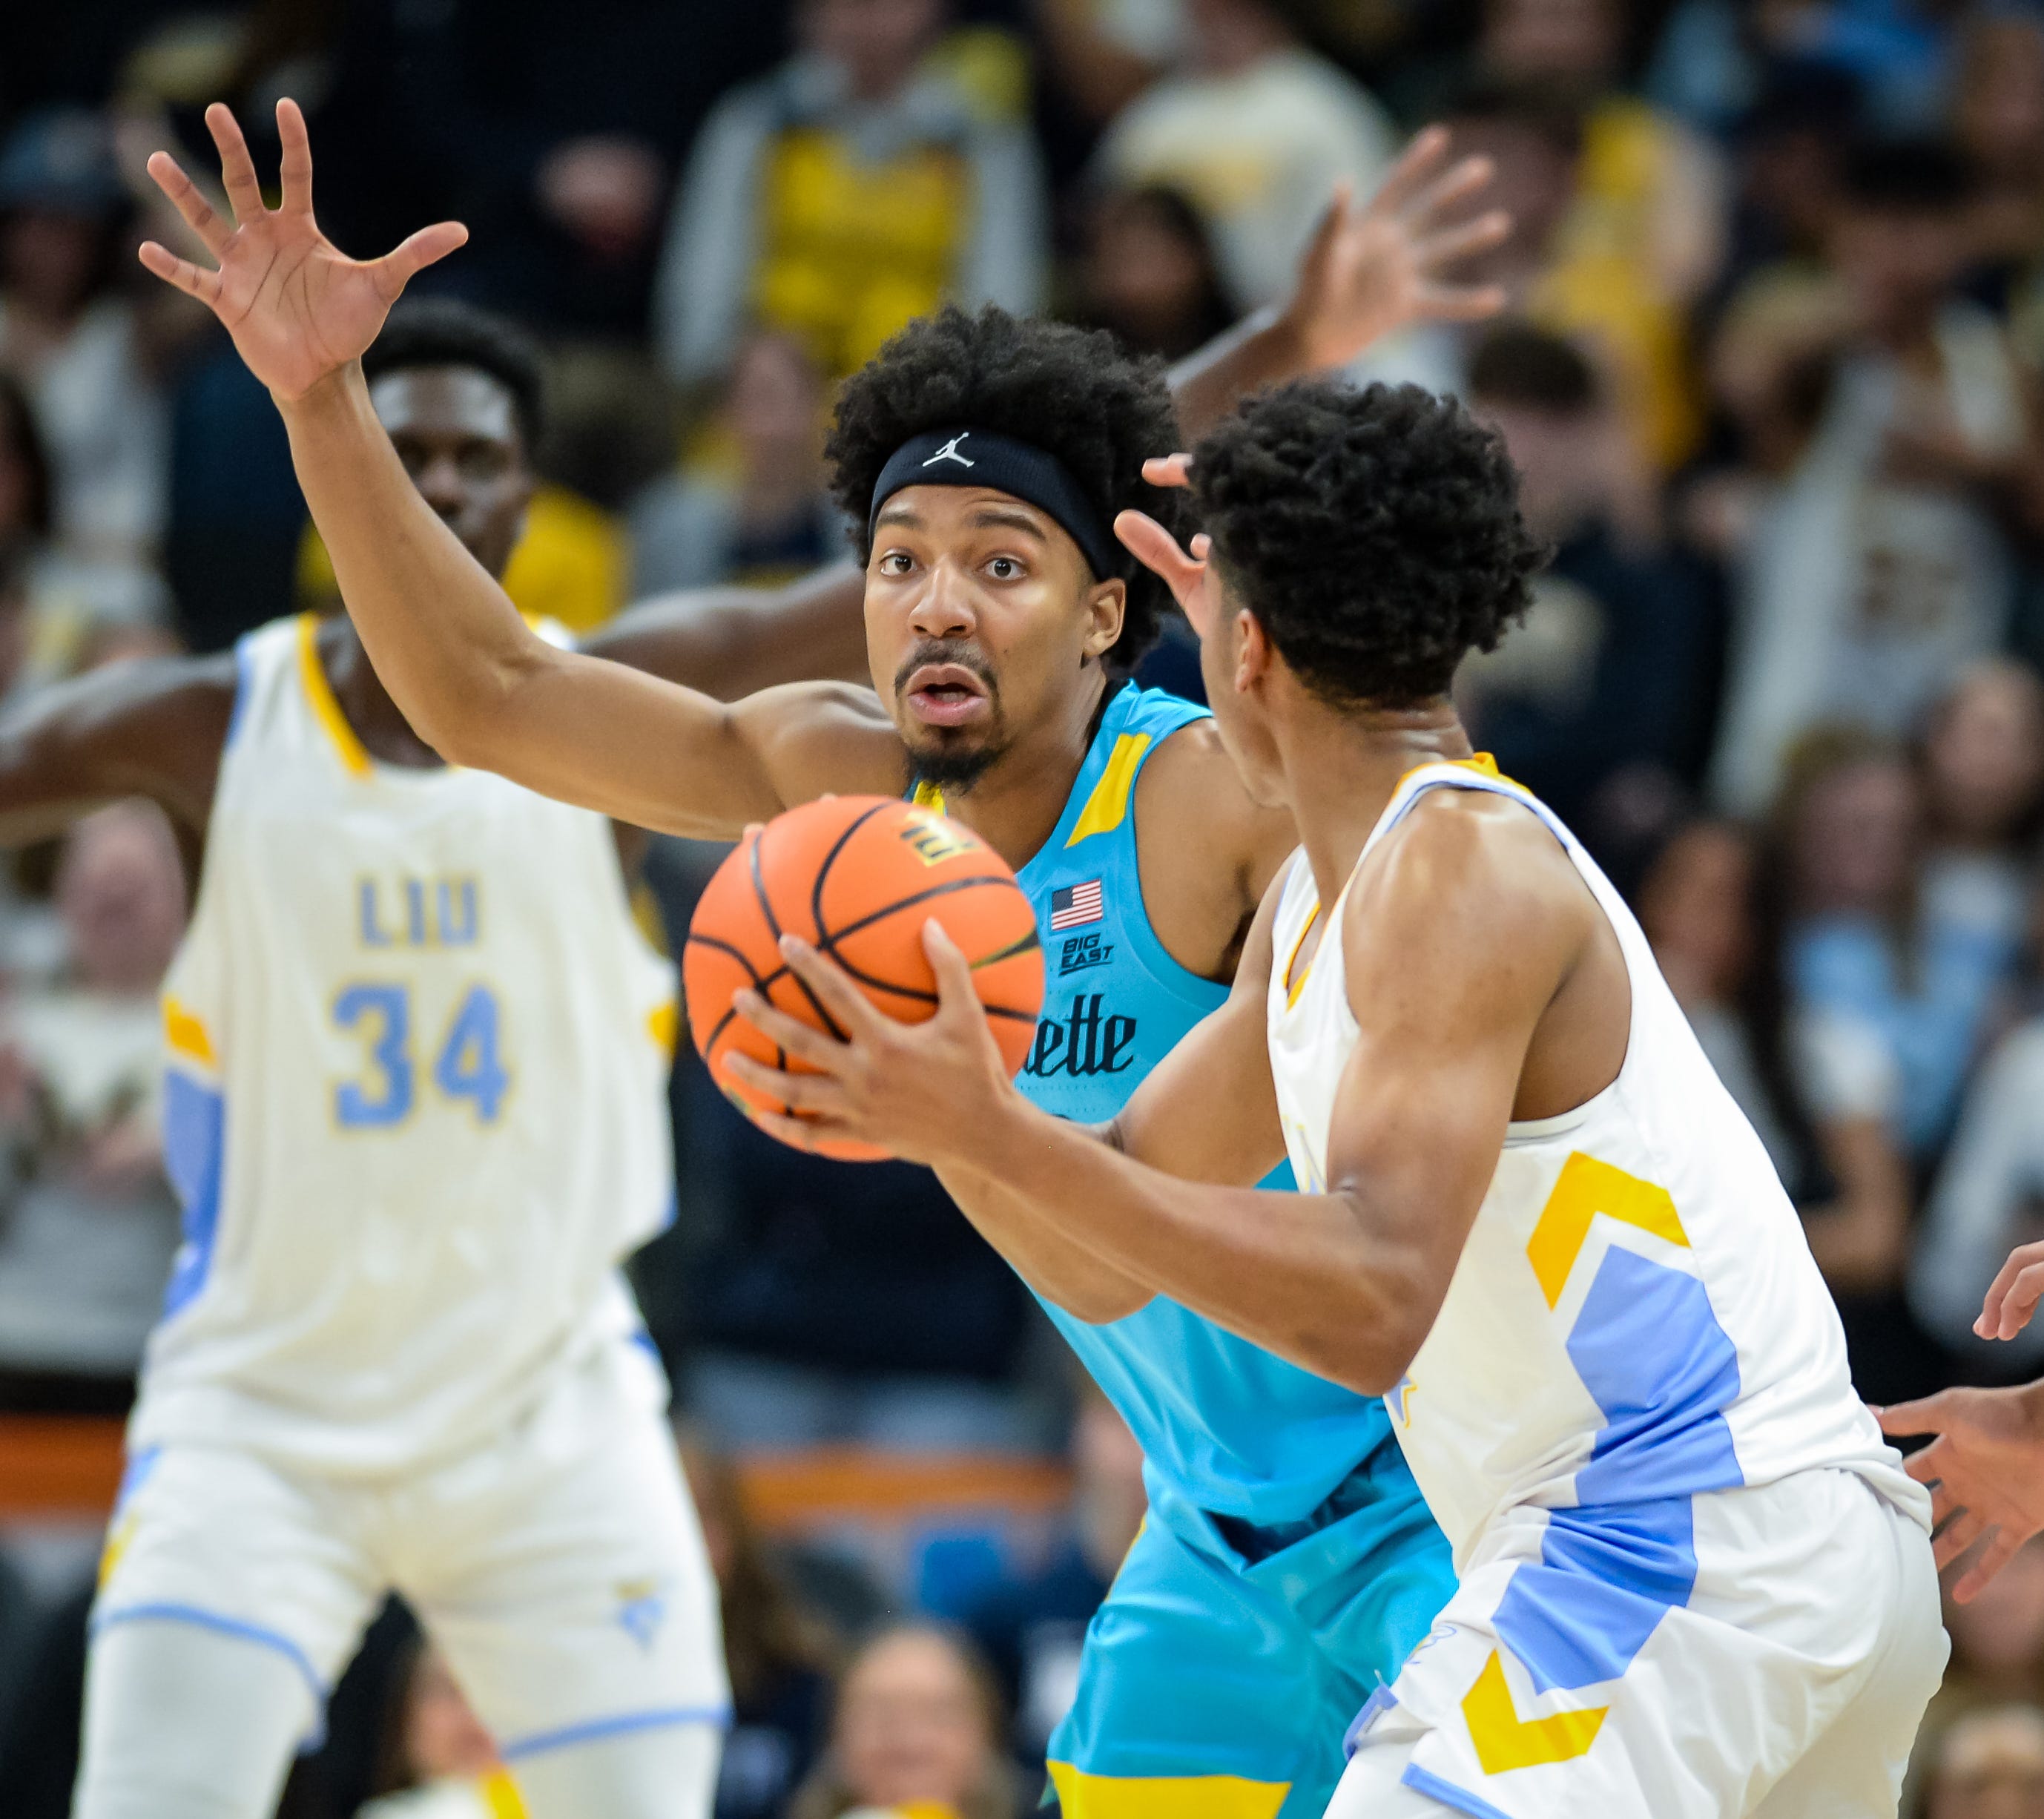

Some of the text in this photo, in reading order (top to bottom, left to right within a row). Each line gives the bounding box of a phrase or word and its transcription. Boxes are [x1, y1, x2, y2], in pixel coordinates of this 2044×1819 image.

[357, 876, 481, 950] LIU
[1063, 932, 1101, 954] BIG
[1061, 945, 1115, 968] EAST
[330, 979, 513, 1132] 34
[1023, 993, 1137, 1077] ette
